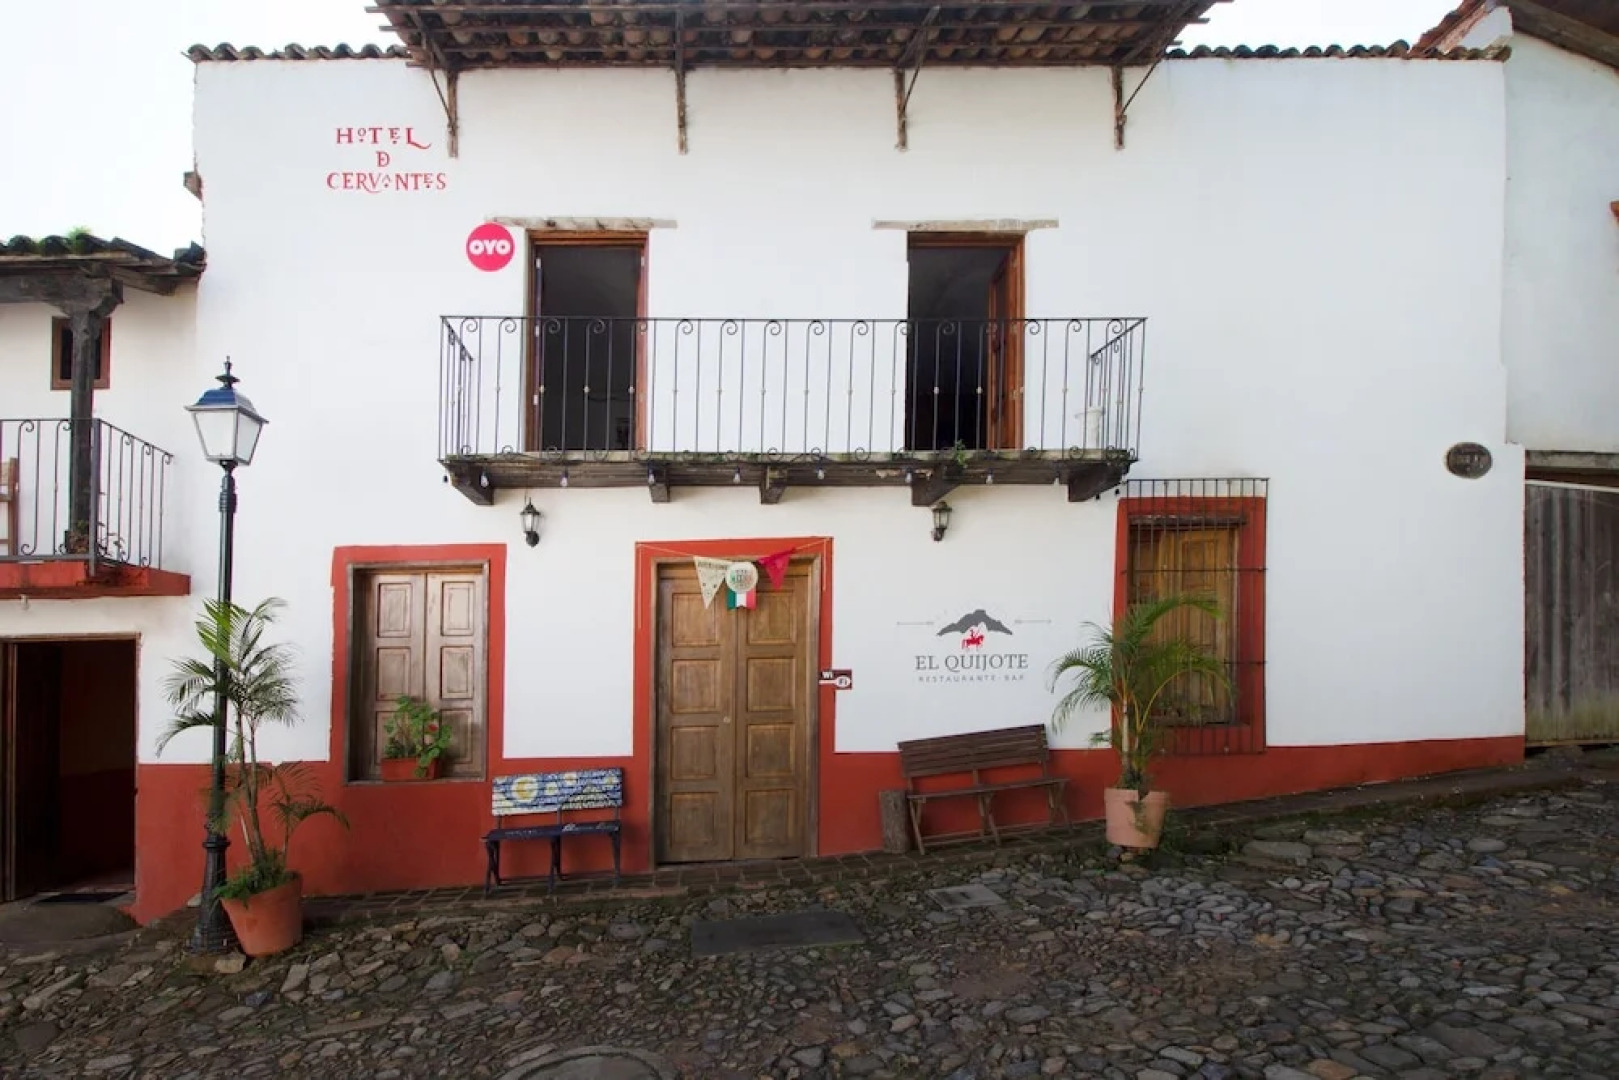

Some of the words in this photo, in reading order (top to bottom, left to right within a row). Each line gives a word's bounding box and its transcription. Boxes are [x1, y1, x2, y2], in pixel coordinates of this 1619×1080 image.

[326, 172, 447, 193] CERVANTES
[469, 239, 511, 256] OYO
[915, 655, 940, 670] EL
[944, 653, 1029, 672] QUIJOTE
